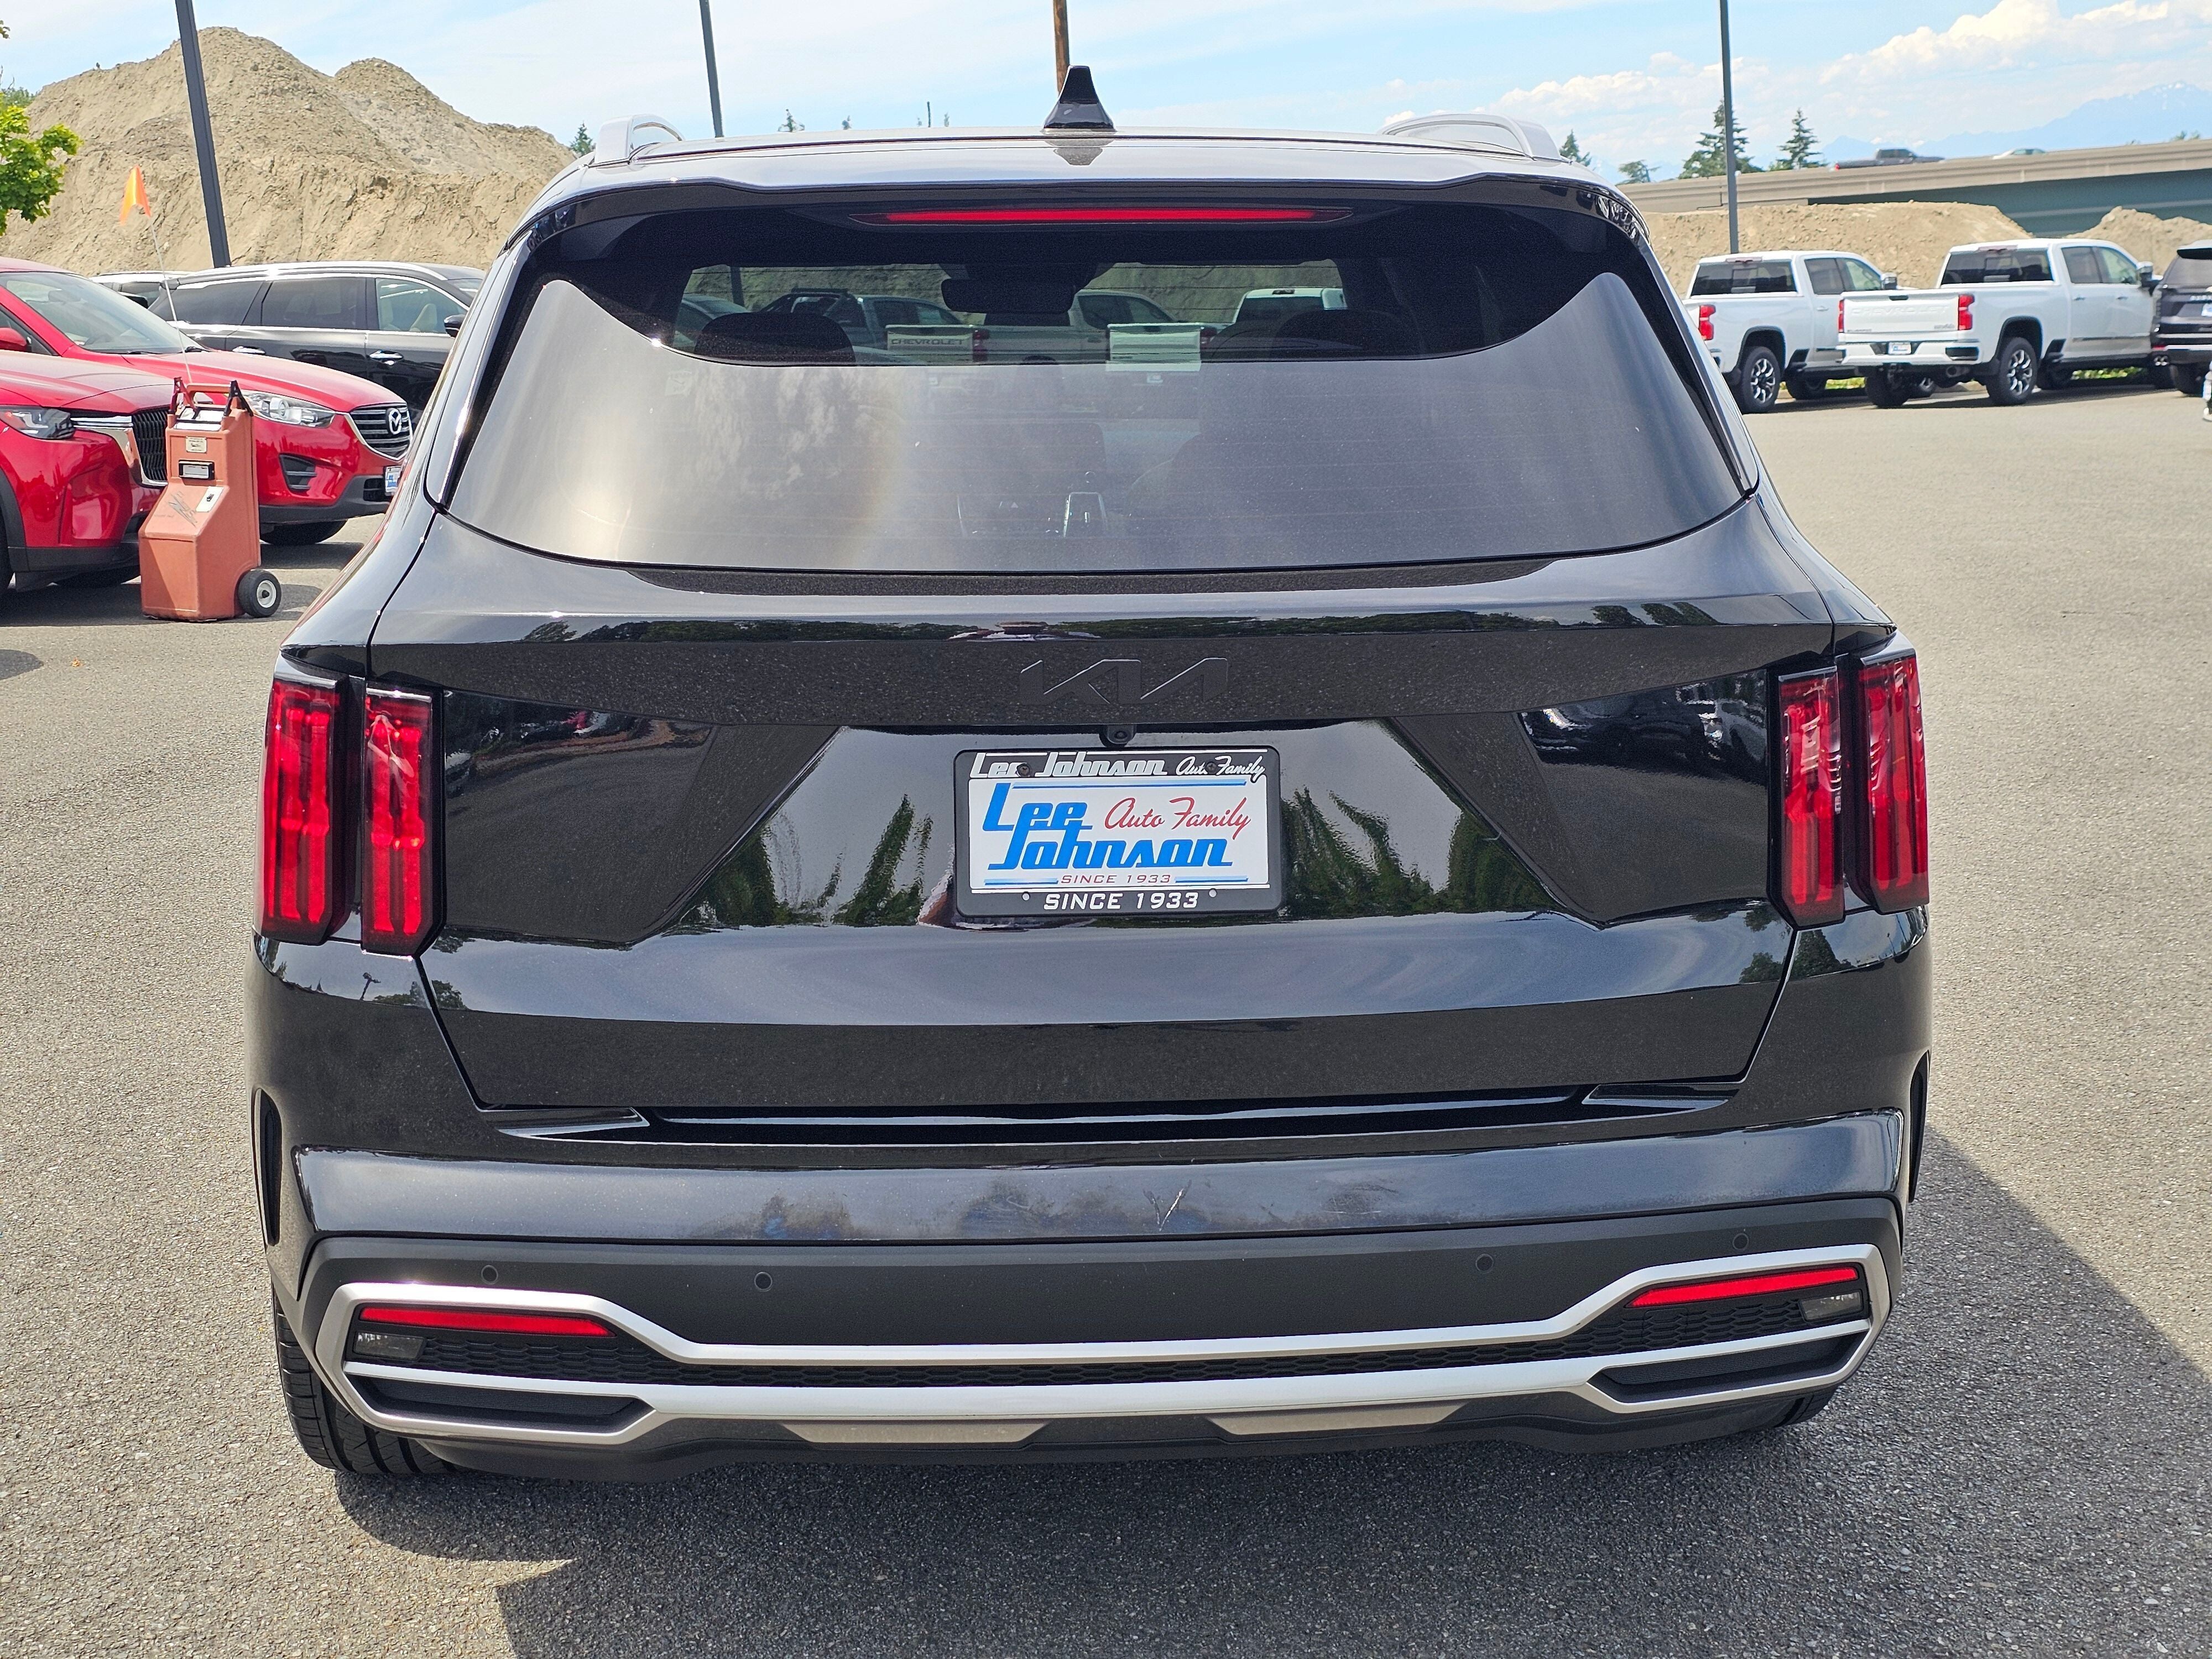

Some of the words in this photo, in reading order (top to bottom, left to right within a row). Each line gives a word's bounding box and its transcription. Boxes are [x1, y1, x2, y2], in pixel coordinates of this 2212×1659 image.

[1851, 306, 1950, 315] CHEVROLET
[1020, 656, 1228, 706] KIA
[1034, 751, 1168, 777] Johnson
[1176, 756, 1209, 775] Aut
[1214, 755, 1265, 783] Family
[982, 782, 1093, 831] Lee
[1105, 797, 1165, 830] Auto
[1169, 796, 1251, 840] Family
[988, 825, 1233, 870] Johnson
[1061, 875, 1118, 884] SINCE
[1126, 874, 1171, 883] 1933
[1043, 893, 1123, 910] SINCE
[1136, 891, 1199, 910] 1933
